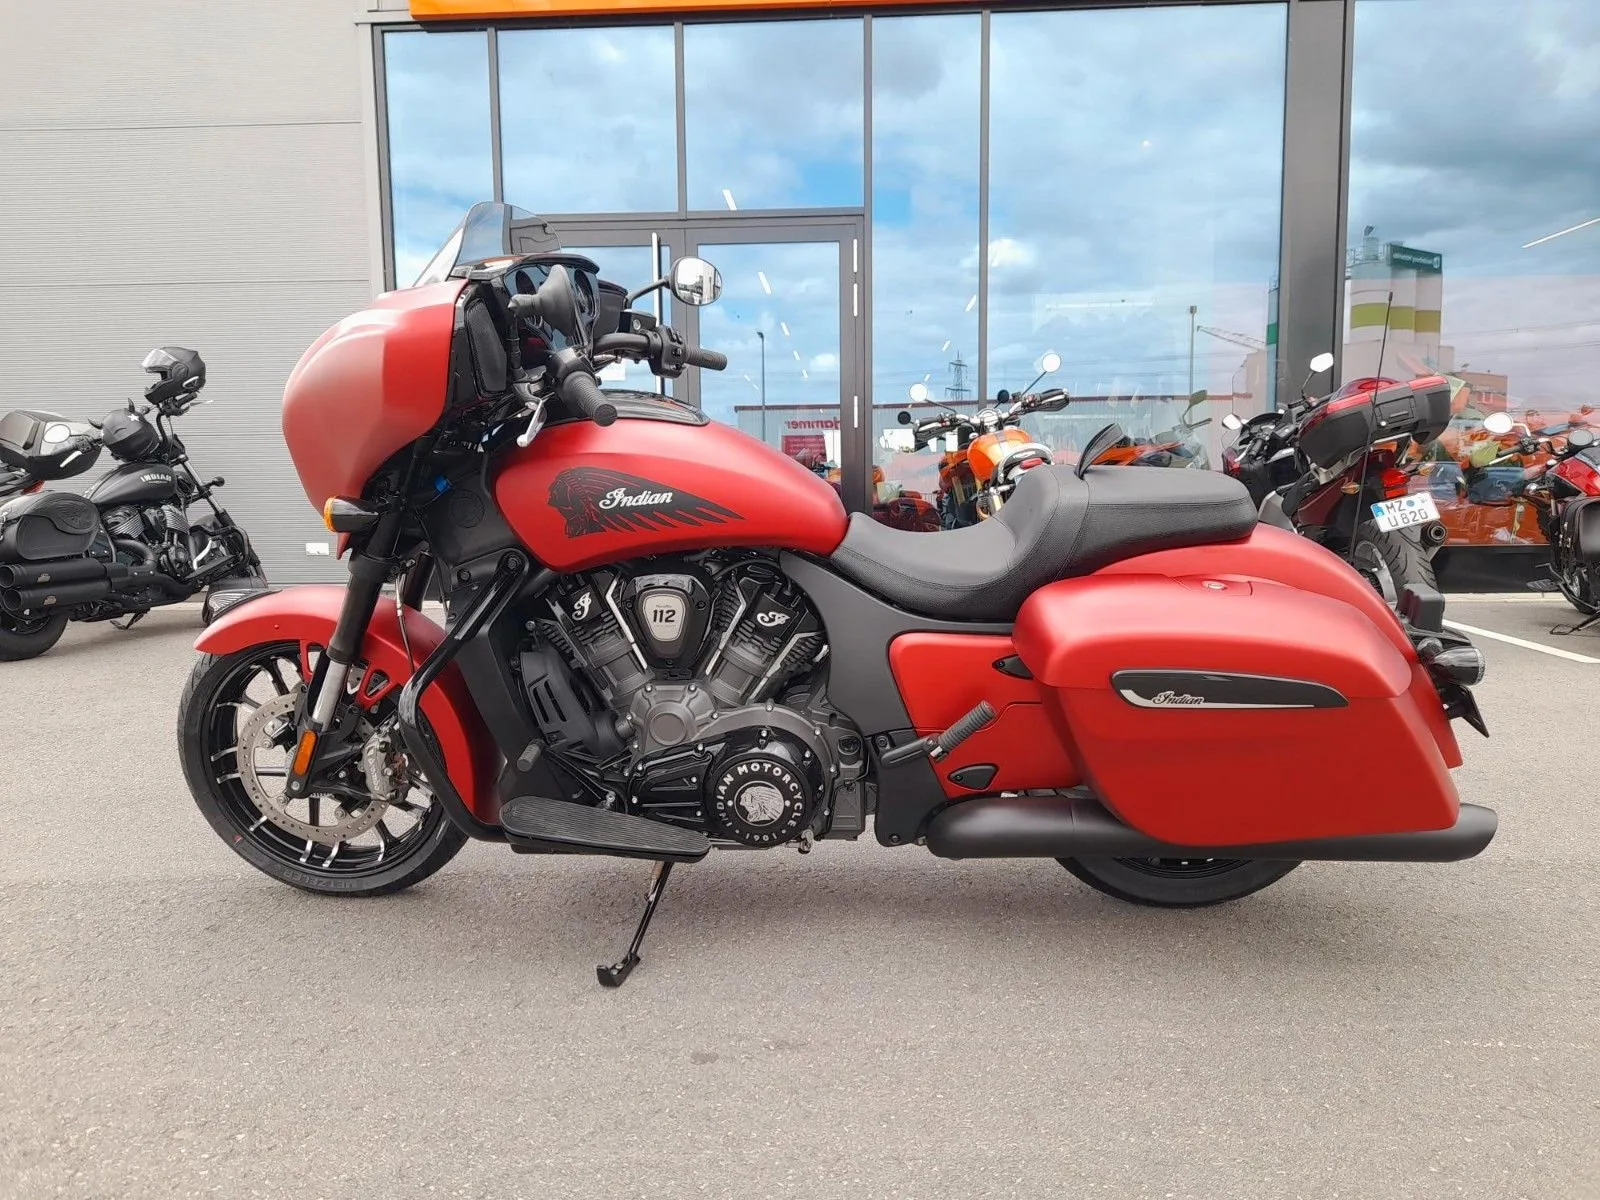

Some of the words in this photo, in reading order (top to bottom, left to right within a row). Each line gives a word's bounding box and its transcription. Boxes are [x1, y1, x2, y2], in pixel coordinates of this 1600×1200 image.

[140, 473, 172, 483] INDIAN
[598, 487, 673, 510] Indian
[1385, 500, 1407, 513] MZ
[652, 609, 676, 623] 112
[1152, 690, 1205, 705] Indian
[716, 773, 735, 828] INDIAN
[736, 762, 803, 828] MOTORCYCLE
[745, 832, 777, 842] 1901
